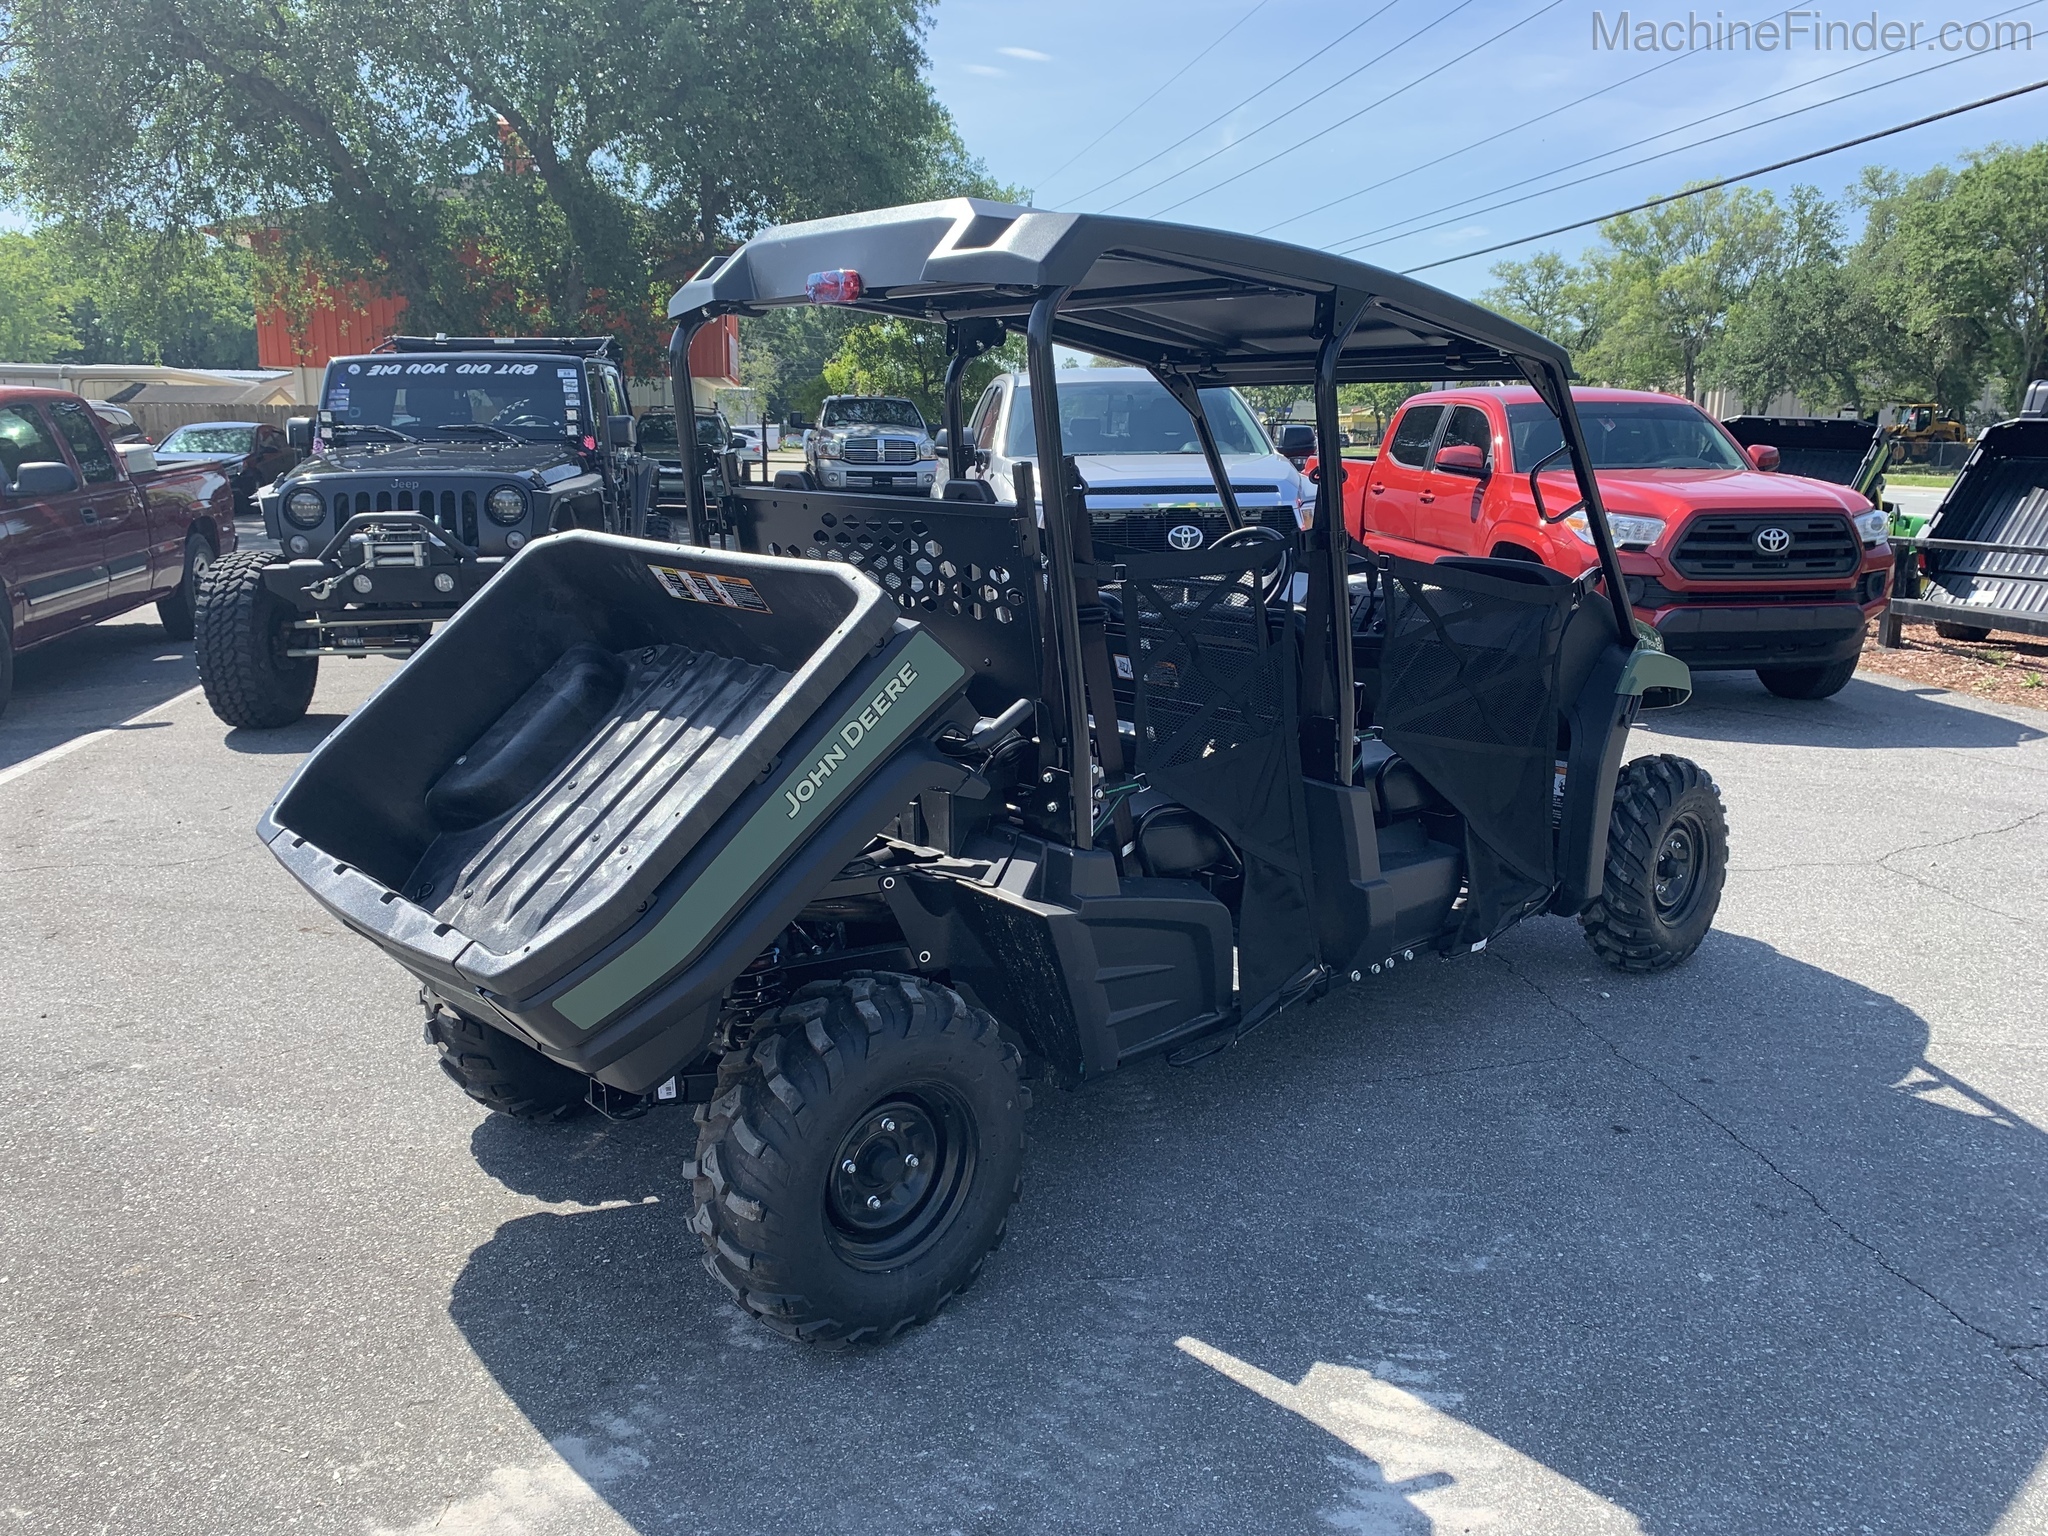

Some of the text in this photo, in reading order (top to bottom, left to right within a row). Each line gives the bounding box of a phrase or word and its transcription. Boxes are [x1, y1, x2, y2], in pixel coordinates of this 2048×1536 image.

[367, 363, 538, 376] BUT DID YOU DIE
[391, 479, 419, 489] Jeep
[784, 661, 920, 819] JOHN DEERE
